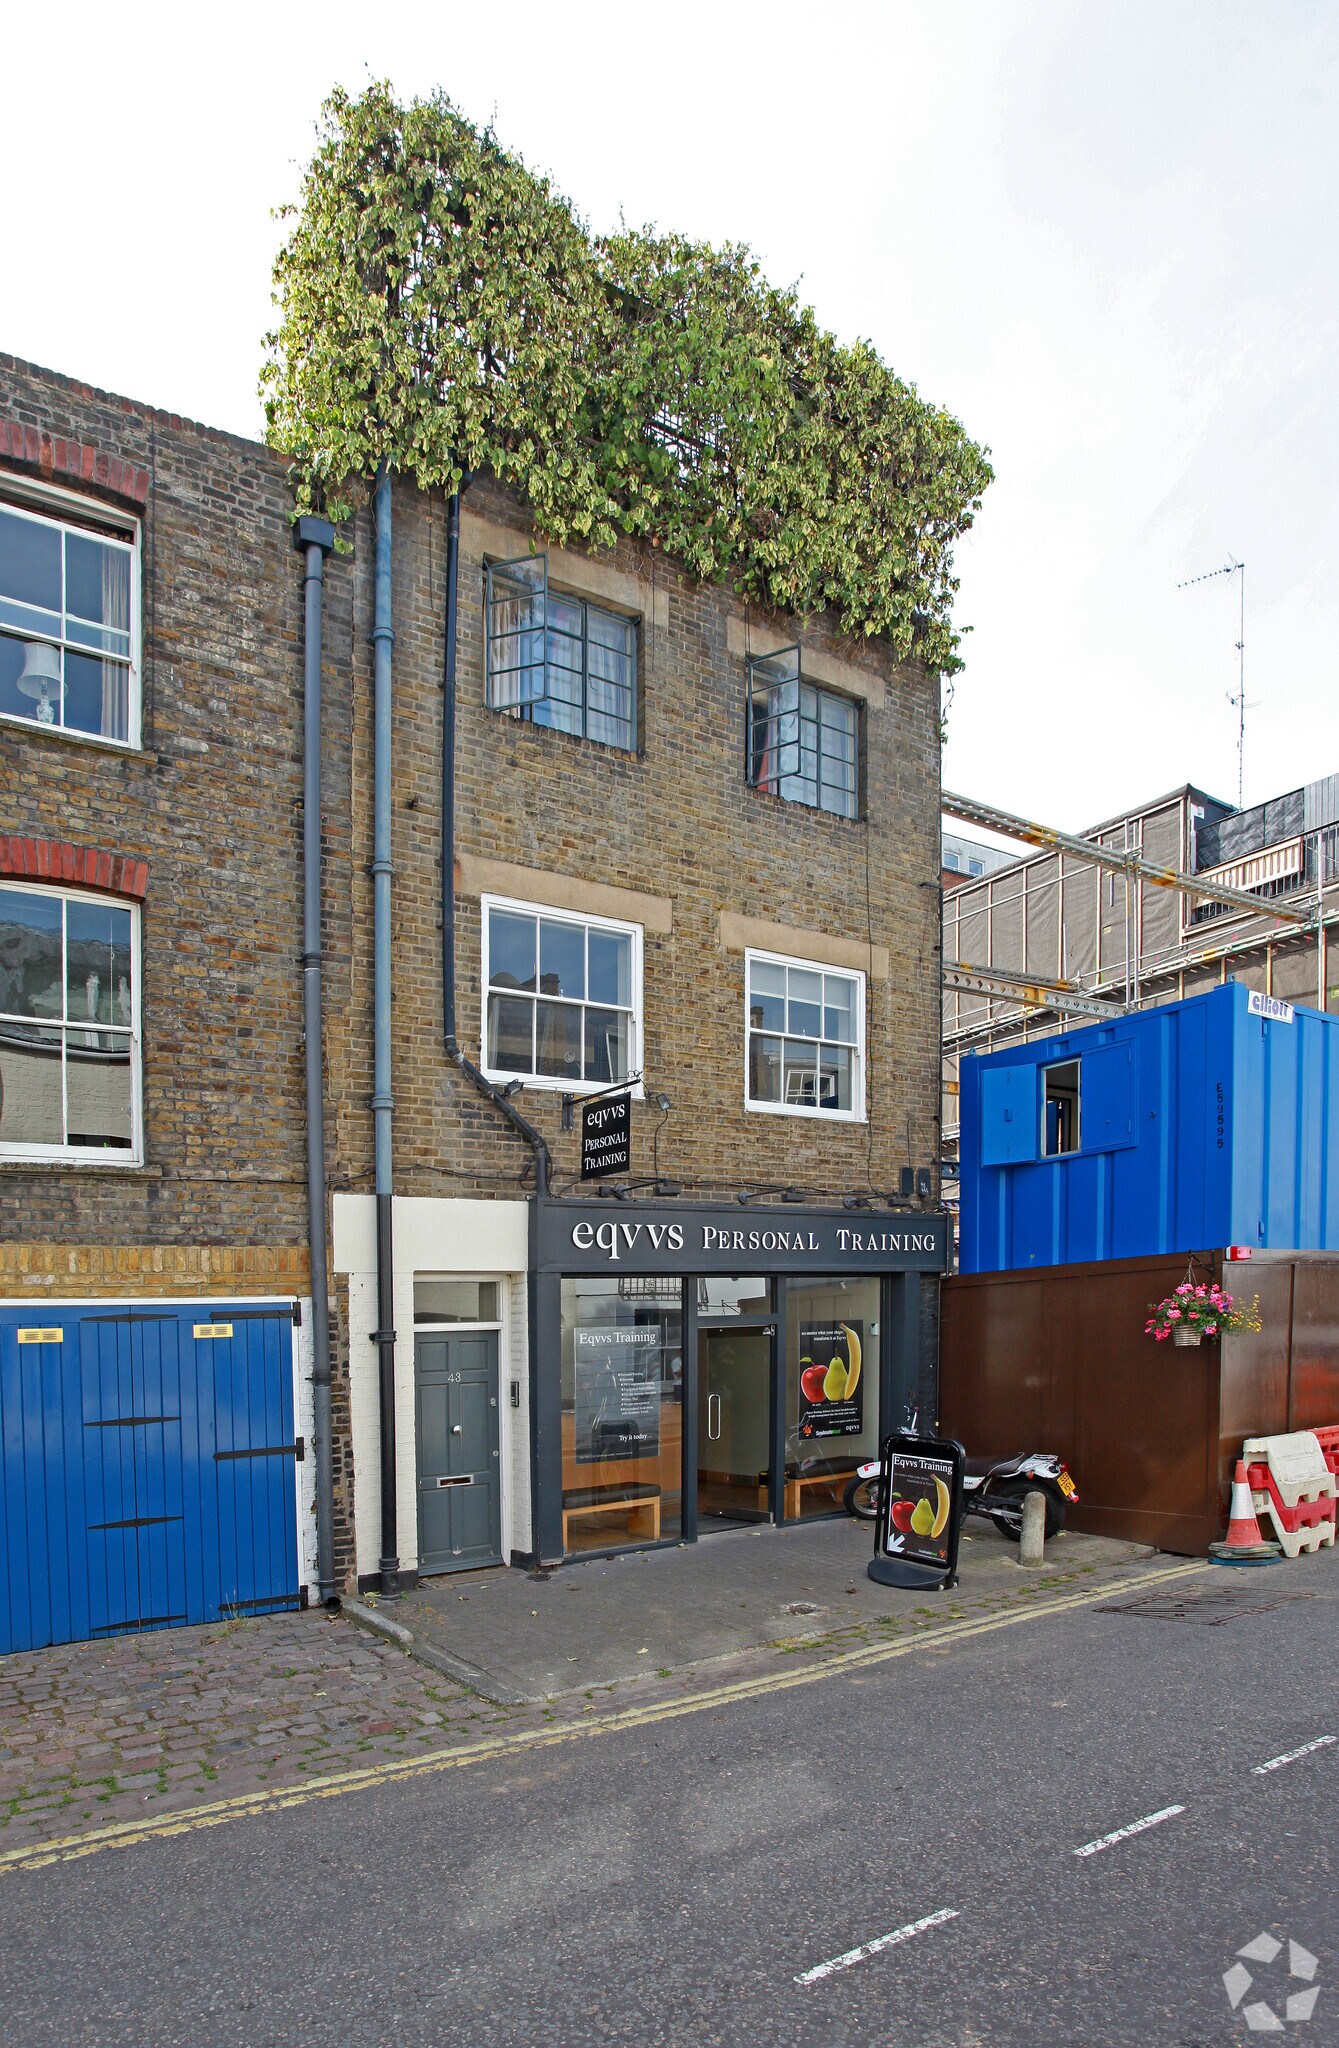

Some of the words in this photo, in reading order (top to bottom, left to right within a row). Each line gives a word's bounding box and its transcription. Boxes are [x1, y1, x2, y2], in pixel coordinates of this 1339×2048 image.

[1252, 994, 1289, 1017] elliott
[587, 1103, 625, 1128] eqvvs
[584, 1131, 627, 1152] PERSONAL
[584, 1151, 627, 1170] TRAINING
[572, 1221, 684, 1260] eqvvs
[702, 1225, 820, 1251] PERSONAL
[835, 1228, 936, 1252] TRAINING
[579, 1331, 612, 1347] Eqvvs
[613, 1330, 656, 1346] Training
[447, 1372, 461, 1383] 43
[618, 1434, 627, 1442] Try
[894, 1456, 918, 1468] Eqvvs
[918, 1460, 953, 1476] Training
